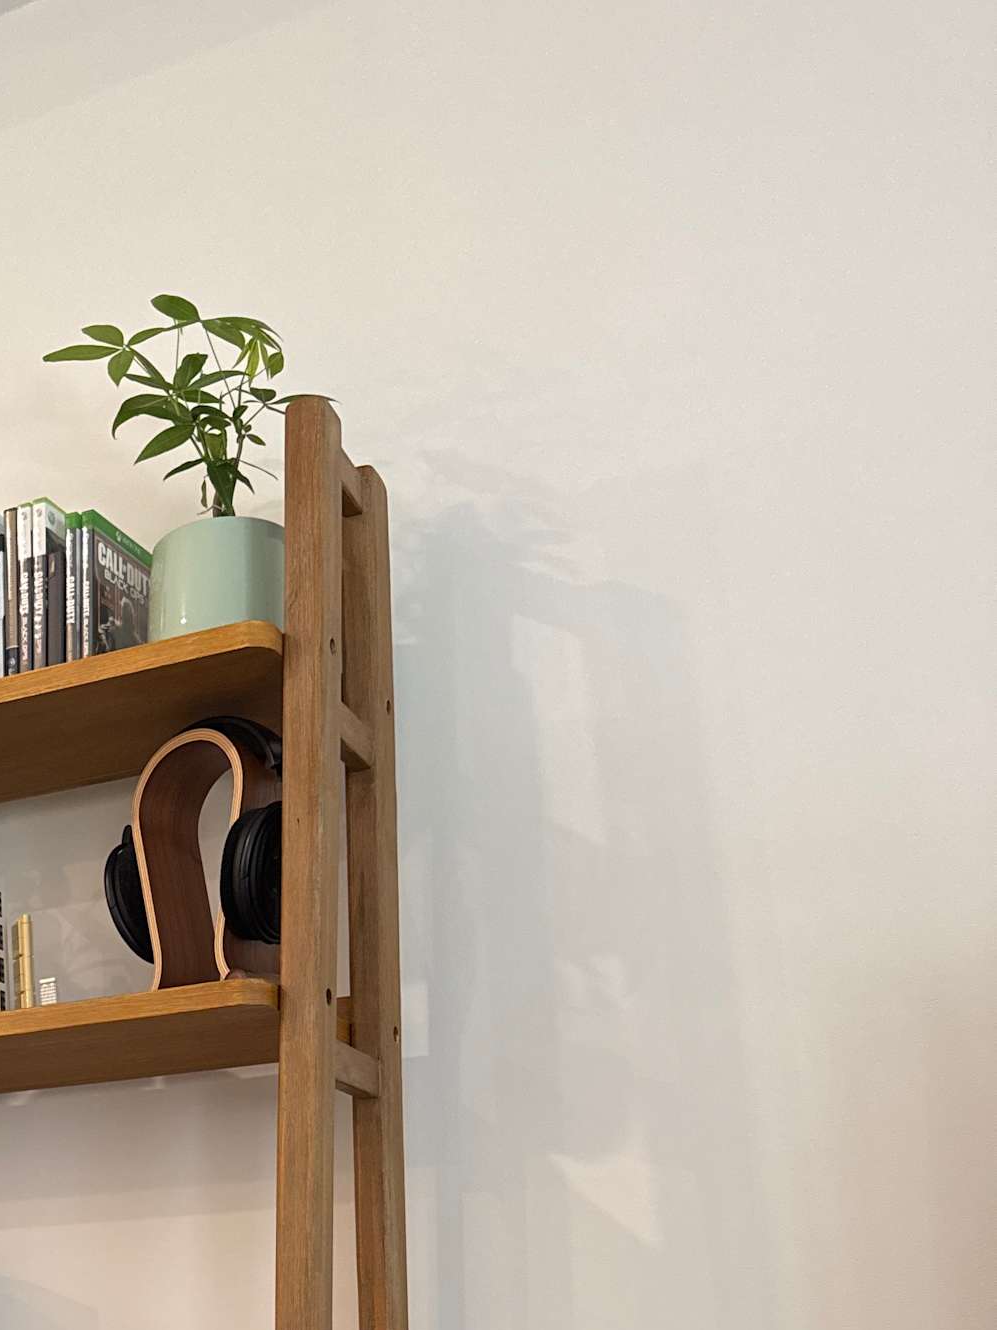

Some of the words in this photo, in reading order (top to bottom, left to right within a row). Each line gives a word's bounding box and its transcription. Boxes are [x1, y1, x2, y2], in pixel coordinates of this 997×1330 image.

[98, 542, 124, 580] CALL
[104, 569, 128, 594] BLACK
[130, 590, 145, 605] OPS
